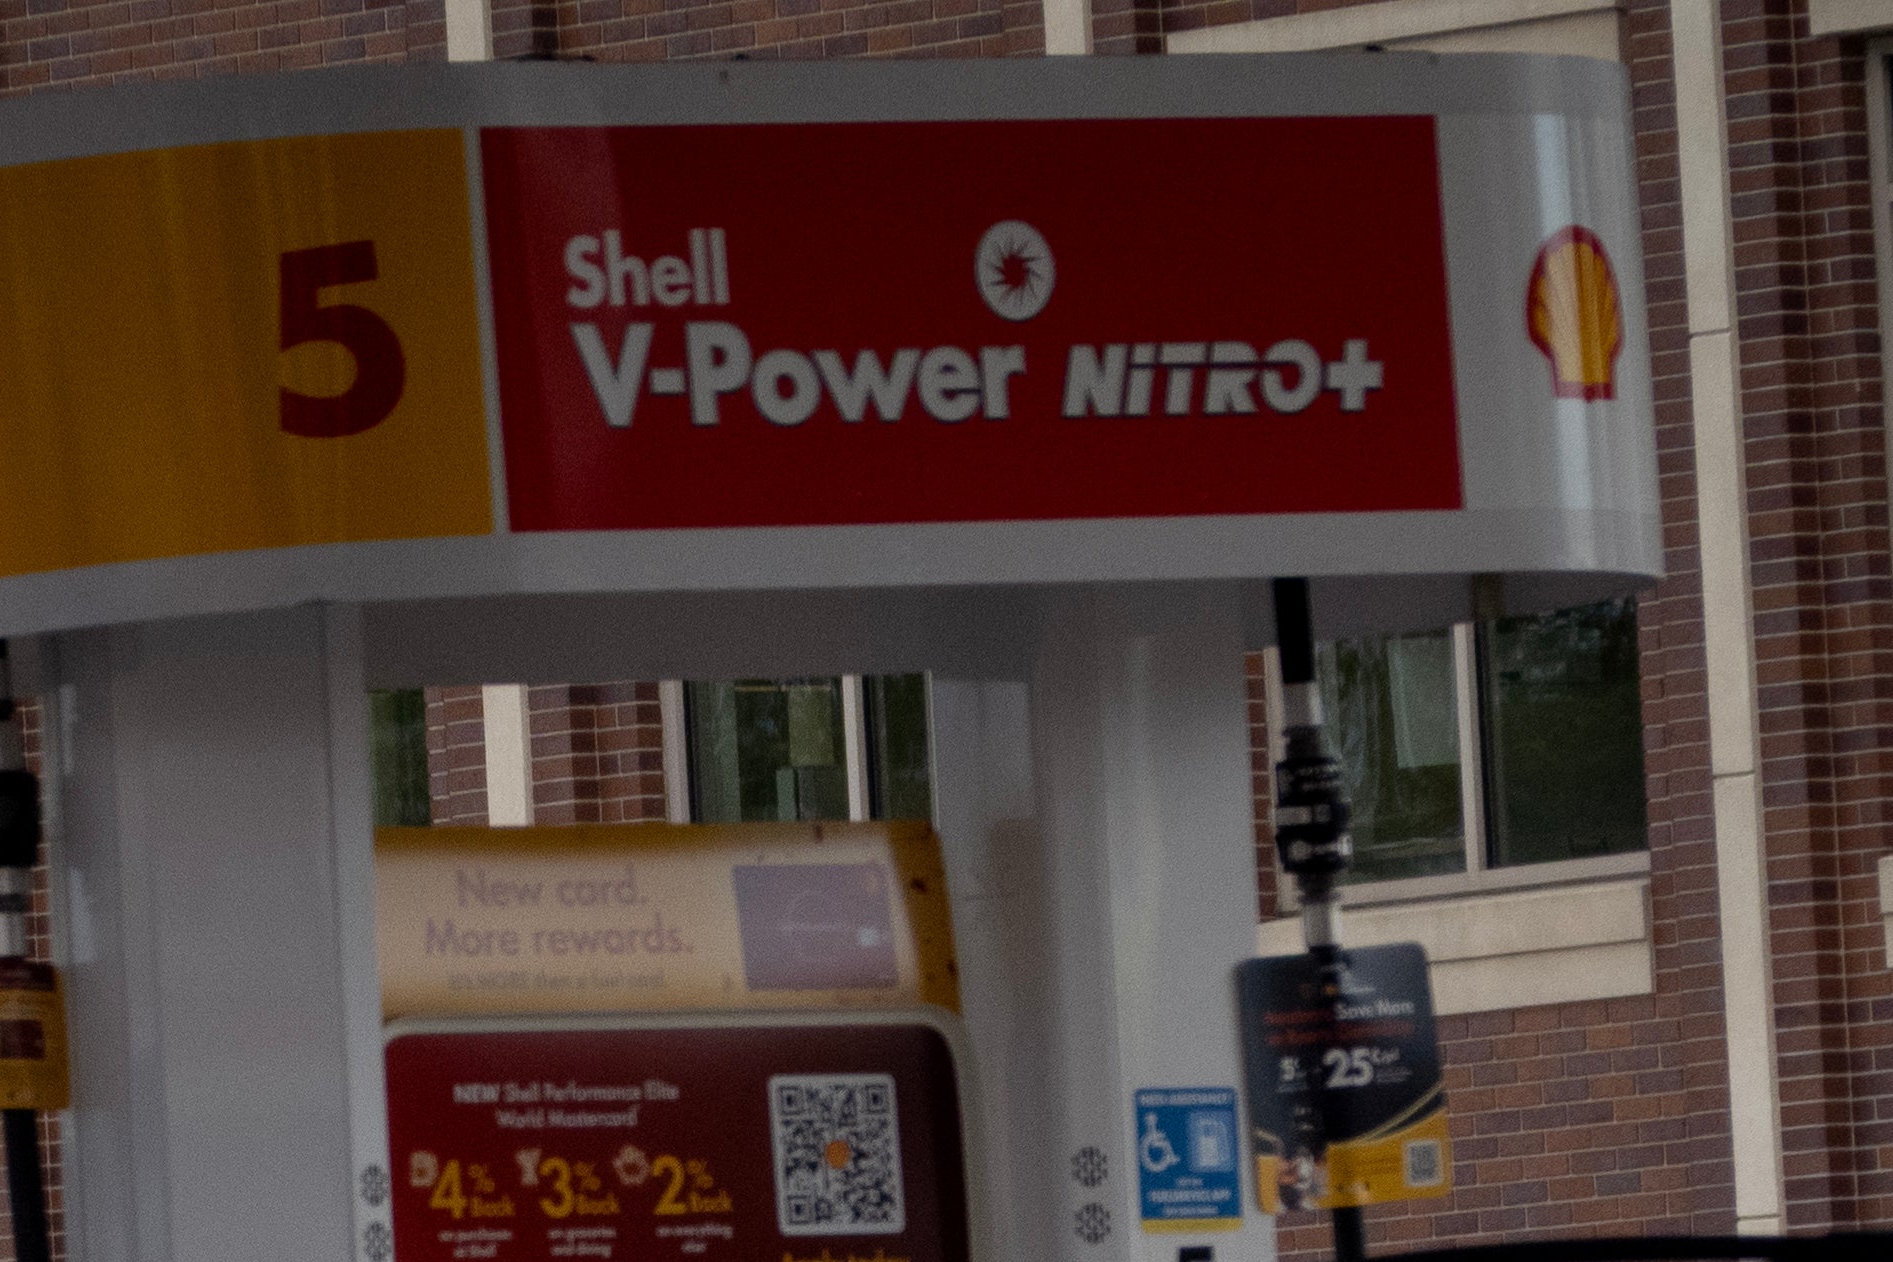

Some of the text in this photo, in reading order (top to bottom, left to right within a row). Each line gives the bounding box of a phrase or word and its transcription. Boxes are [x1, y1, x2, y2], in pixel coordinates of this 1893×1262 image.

[563, 228, 729, 308] Shell
[280, 240, 406, 438] 5
[570, 321, 1026, 428] V-Power
[456, 862, 649, 908] New card.
[423, 911, 694, 957] More rewards.
[1336, 1001, 1372, 1020] Save
[453, 1083, 499, 1104] NEW
